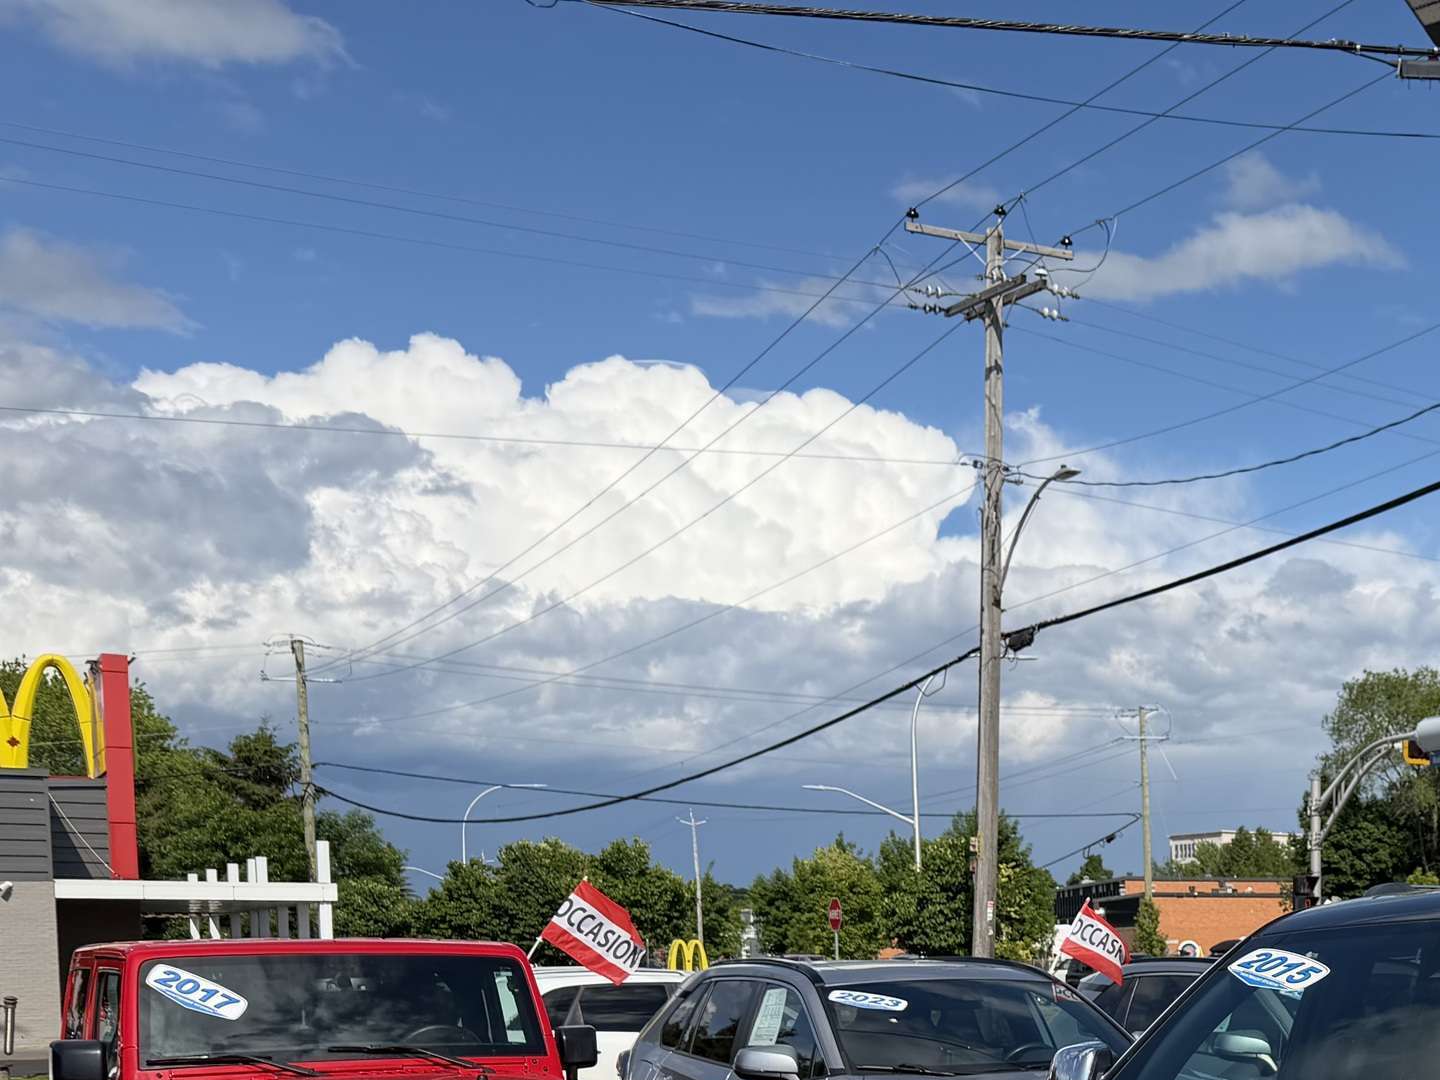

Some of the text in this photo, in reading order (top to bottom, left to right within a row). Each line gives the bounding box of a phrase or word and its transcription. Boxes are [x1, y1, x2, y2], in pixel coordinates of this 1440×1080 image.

[556, 899, 644, 968] OCCASION
[1237, 952, 1323, 984] 2015
[154, 970, 240, 1009] 2017
[837, 992, 902, 1008] 2023
